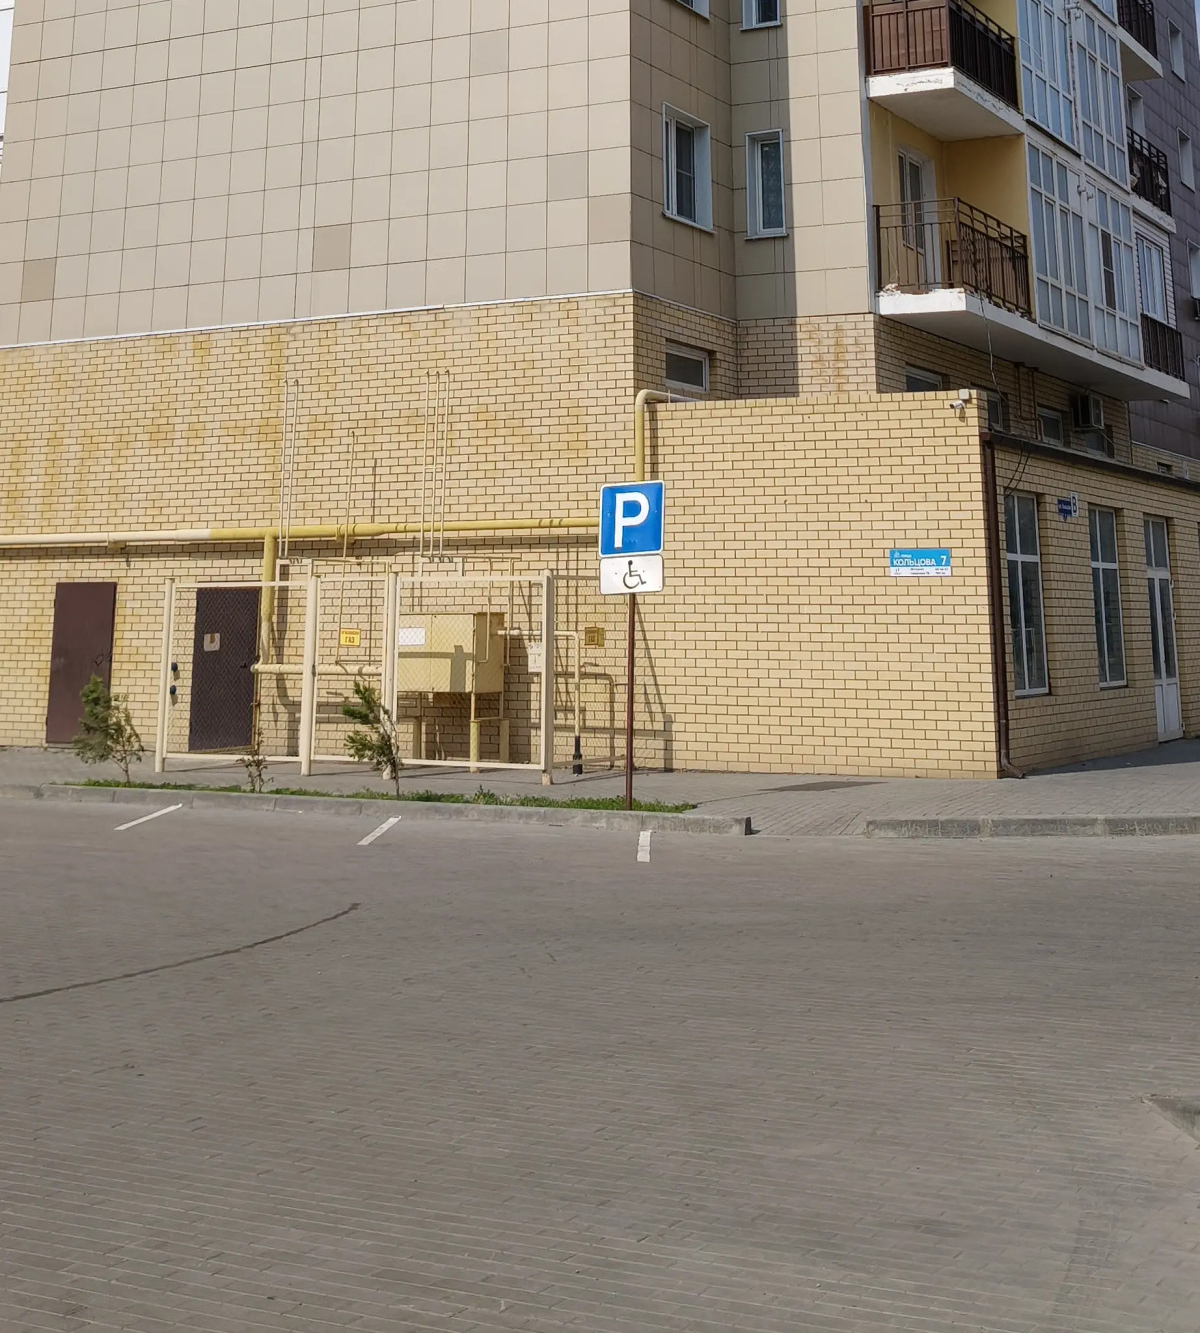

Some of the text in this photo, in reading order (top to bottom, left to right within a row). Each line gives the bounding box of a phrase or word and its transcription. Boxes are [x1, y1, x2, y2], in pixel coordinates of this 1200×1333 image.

[614, 491, 650, 549] P
[892, 555, 947, 567] КОЛЬЦОВА 7
[344, 636, 355, 644] ГАЗ
